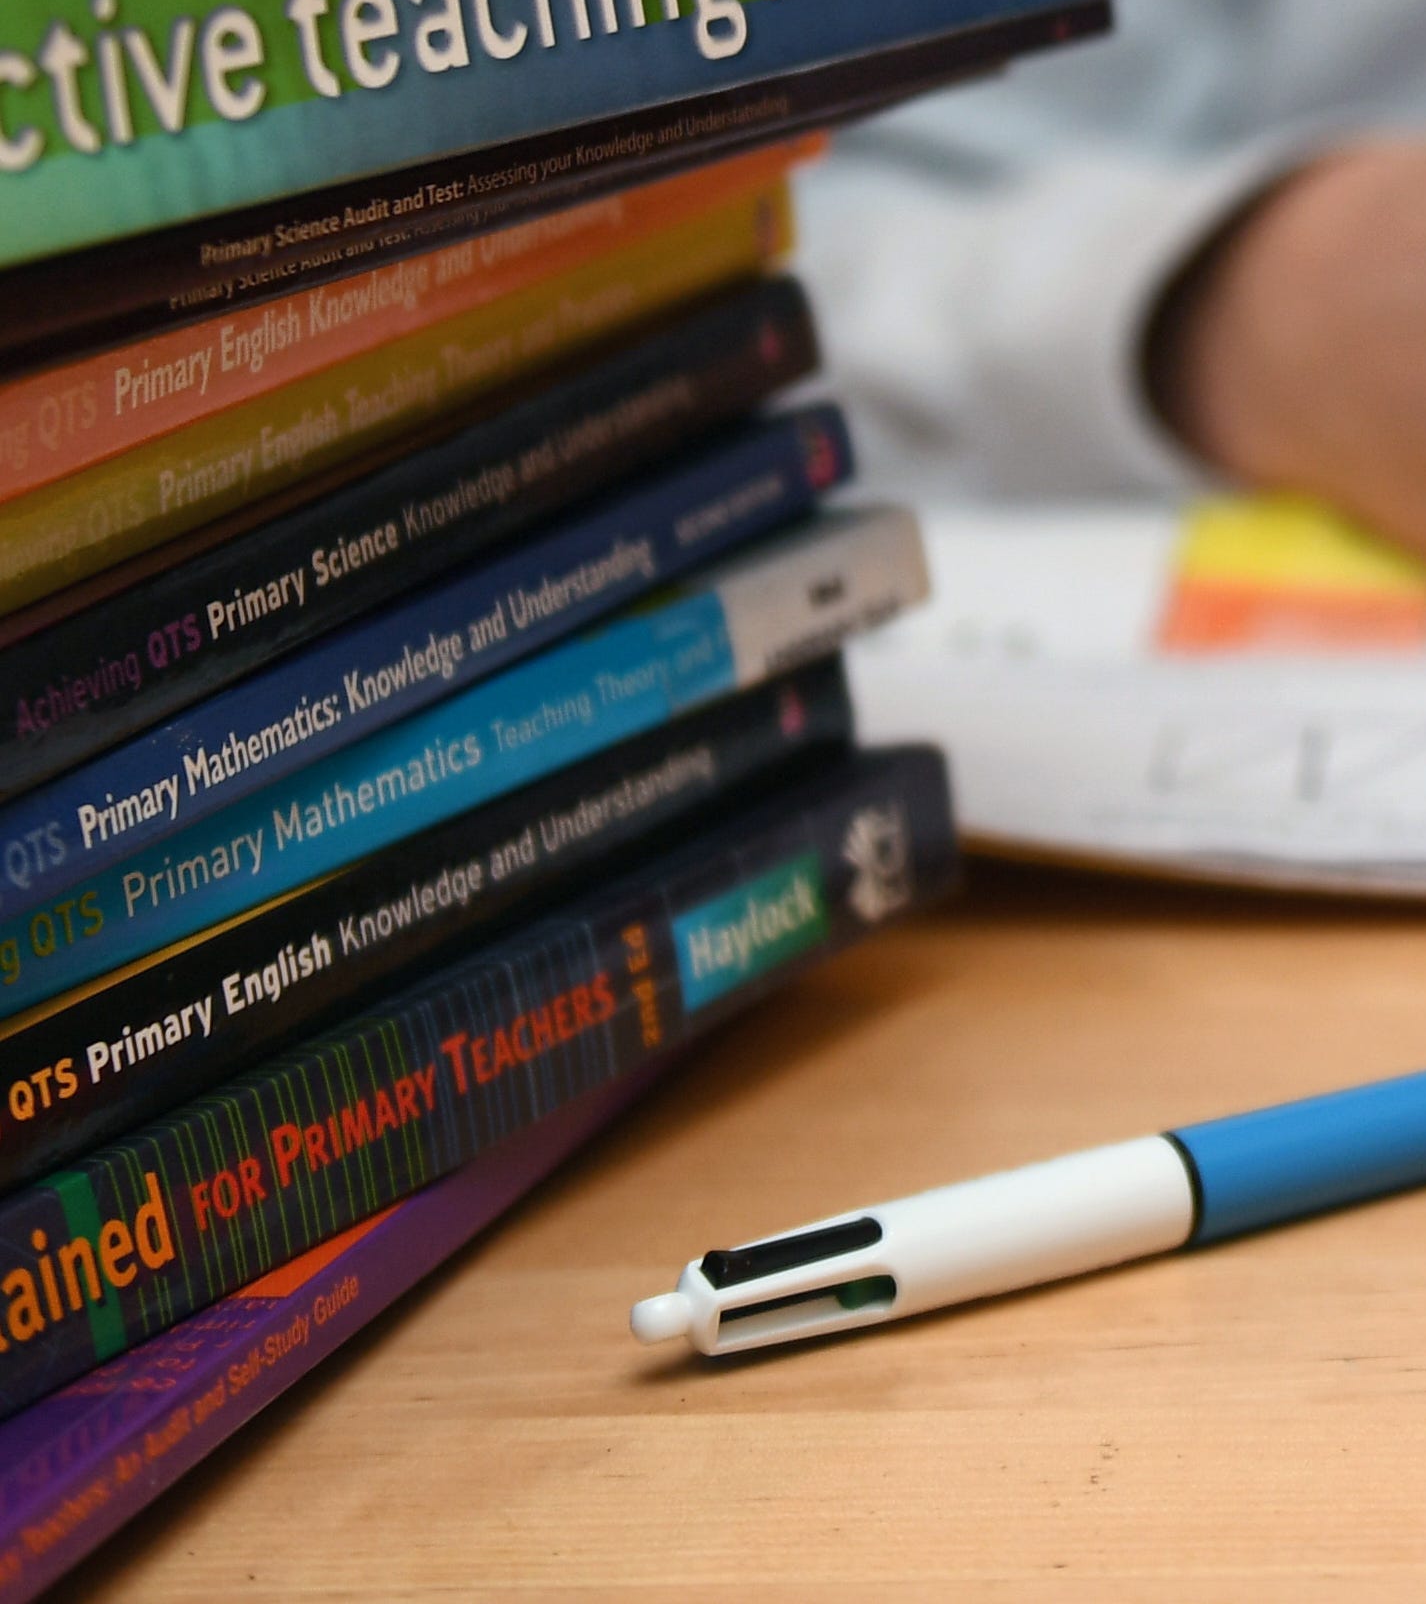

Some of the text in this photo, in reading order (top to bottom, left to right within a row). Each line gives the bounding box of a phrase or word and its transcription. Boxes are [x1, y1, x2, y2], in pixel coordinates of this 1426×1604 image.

[201, 232, 274, 266] Primary
[275, 213, 339, 249] Science
[343, 199, 390, 231] Audit
[393, 186, 424, 216] and
[426, 181, 464, 206] Test:
[467, 162, 538, 194] Assessing
[541, 151, 573, 180] your
[576, 128, 654, 165] Knowledge
[657, 119, 684, 145] and
[38, 378, 97, 451] QTS
[115, 344, 213, 416] Primary
[220, 302, 302, 373] English
[309, 258, 428, 338] Knowledge
[436, 242, 474, 285] and
[159, 442, 254, 514] Primary
[261, 402, 340, 472] English
[6, 822, 67, 890] QTS
[77, 772, 181, 850] Primary
[183, 693, 343, 797] Mathematics:
[343, 629, 464, 716] Knowledge
[470, 605, 507, 653] and
[508, 537, 657, 630] Understanding
[15, 650, 142, 739] Achieving
[147, 611, 202, 669] QTS
[206, 567, 305, 640] Primary
[312, 519, 399, 586] Science
[402, 463, 516, 540] Knowledge
[29, 889, 106, 957] QTS
[122, 827, 264, 918] Primary
[272, 729, 483, 852] Mathematics
[490, 694, 592, 755] Teaching
[594, 656, 674, 705] Theory
[8, 742, 716, 1122] QTS Primary English Knowledge and Understanding
[686, 870, 820, 980] Haylock
[190, 1154, 268, 1232] FOR
[270, 1062, 437, 1188] PRIMARY
[438, 971, 618, 1090] TEACHERS
[227, 1313, 311, 1397] Self-Study
[312, 1274, 361, 1327] Guide
